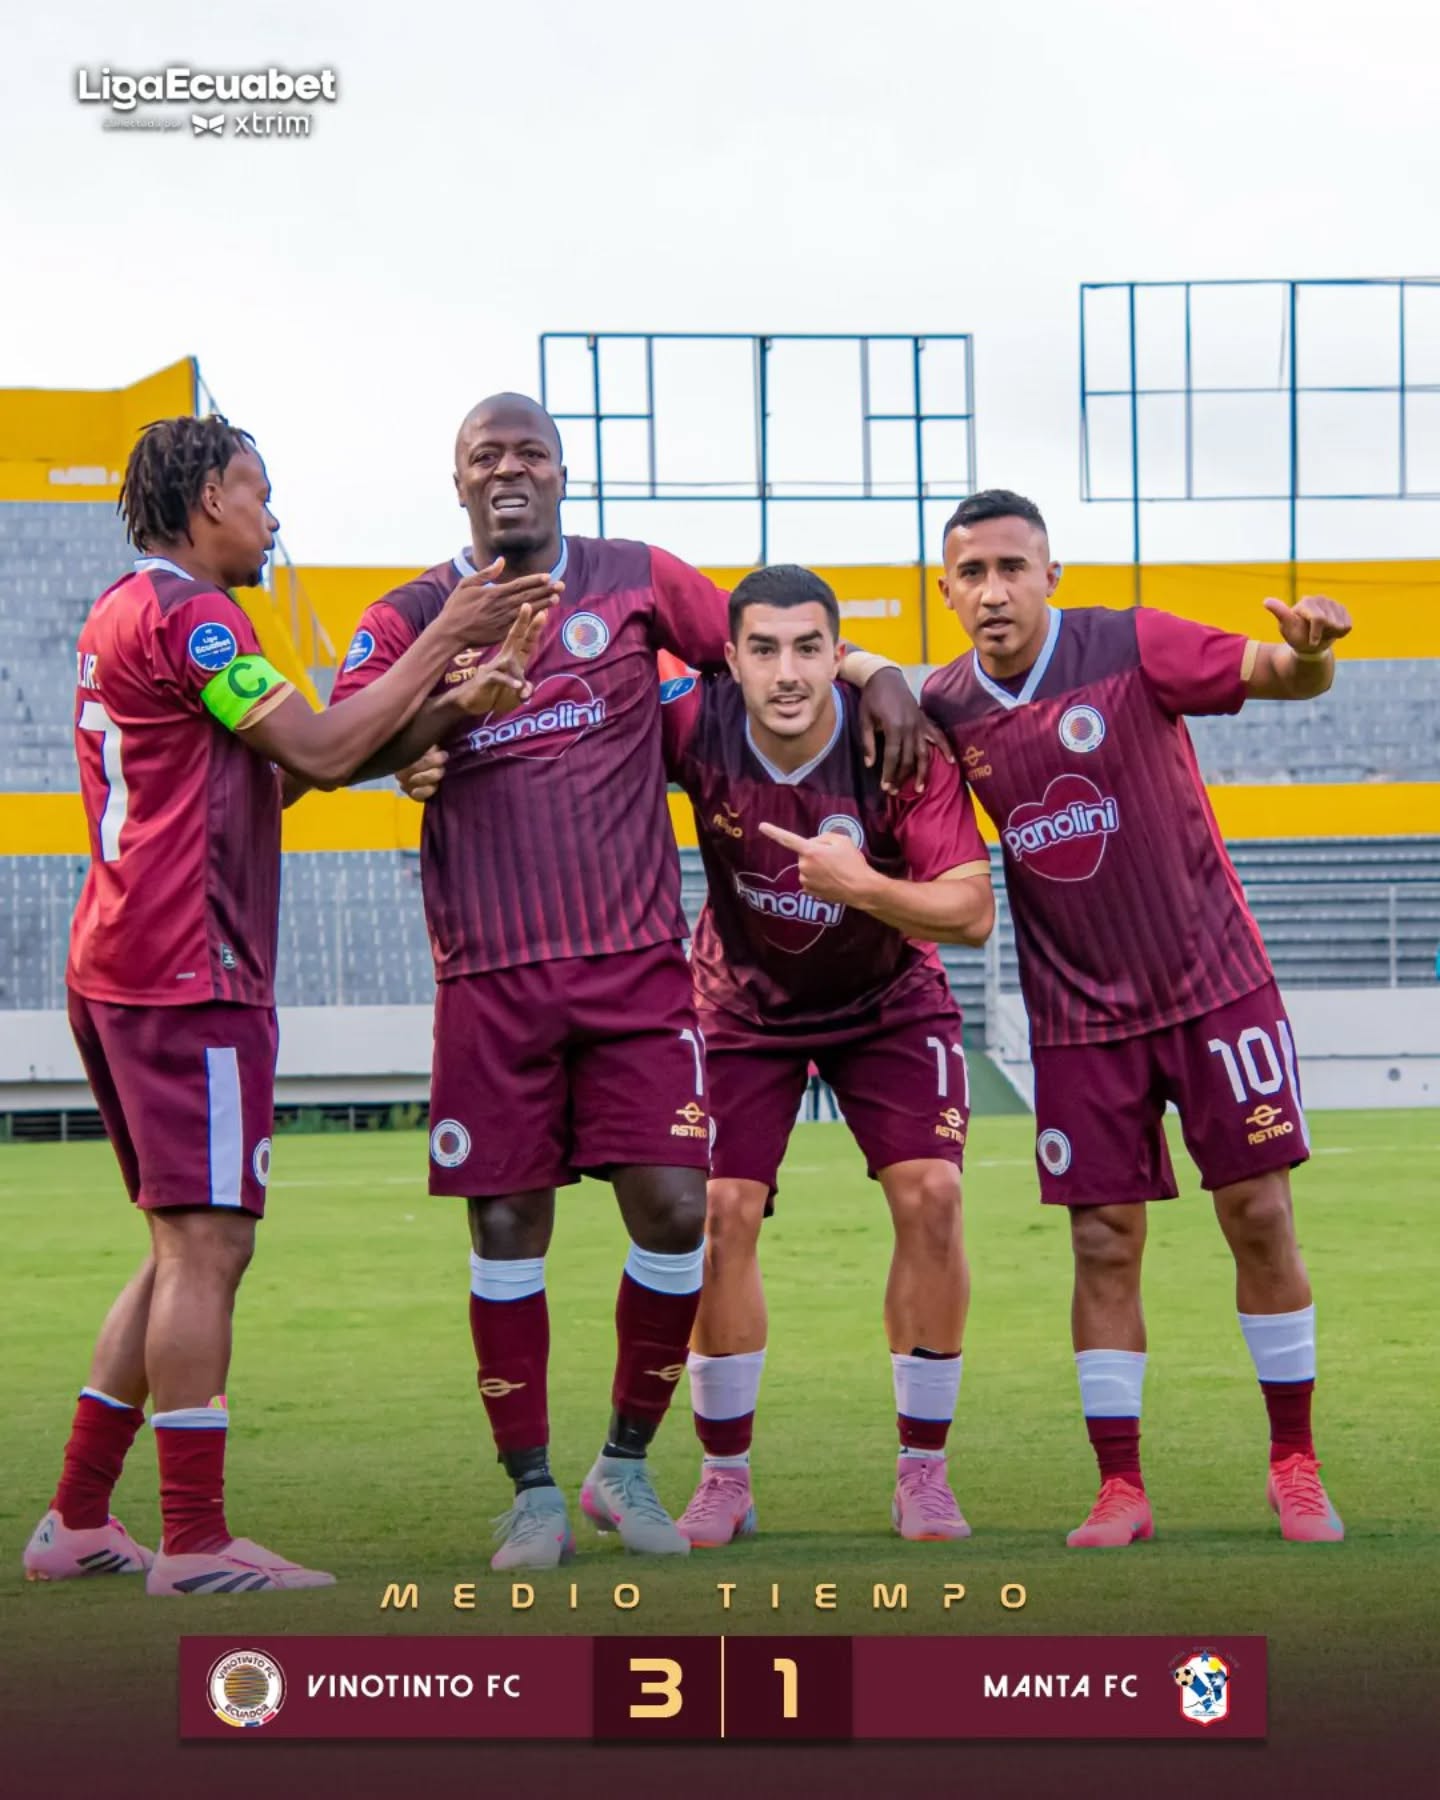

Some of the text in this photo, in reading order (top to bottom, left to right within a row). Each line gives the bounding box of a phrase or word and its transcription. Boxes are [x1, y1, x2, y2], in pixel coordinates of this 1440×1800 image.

[228, 662, 267, 699] C
[1207, 1026, 1283, 1103] 10
[1247, 1121, 1293, 1145] ASTRO
